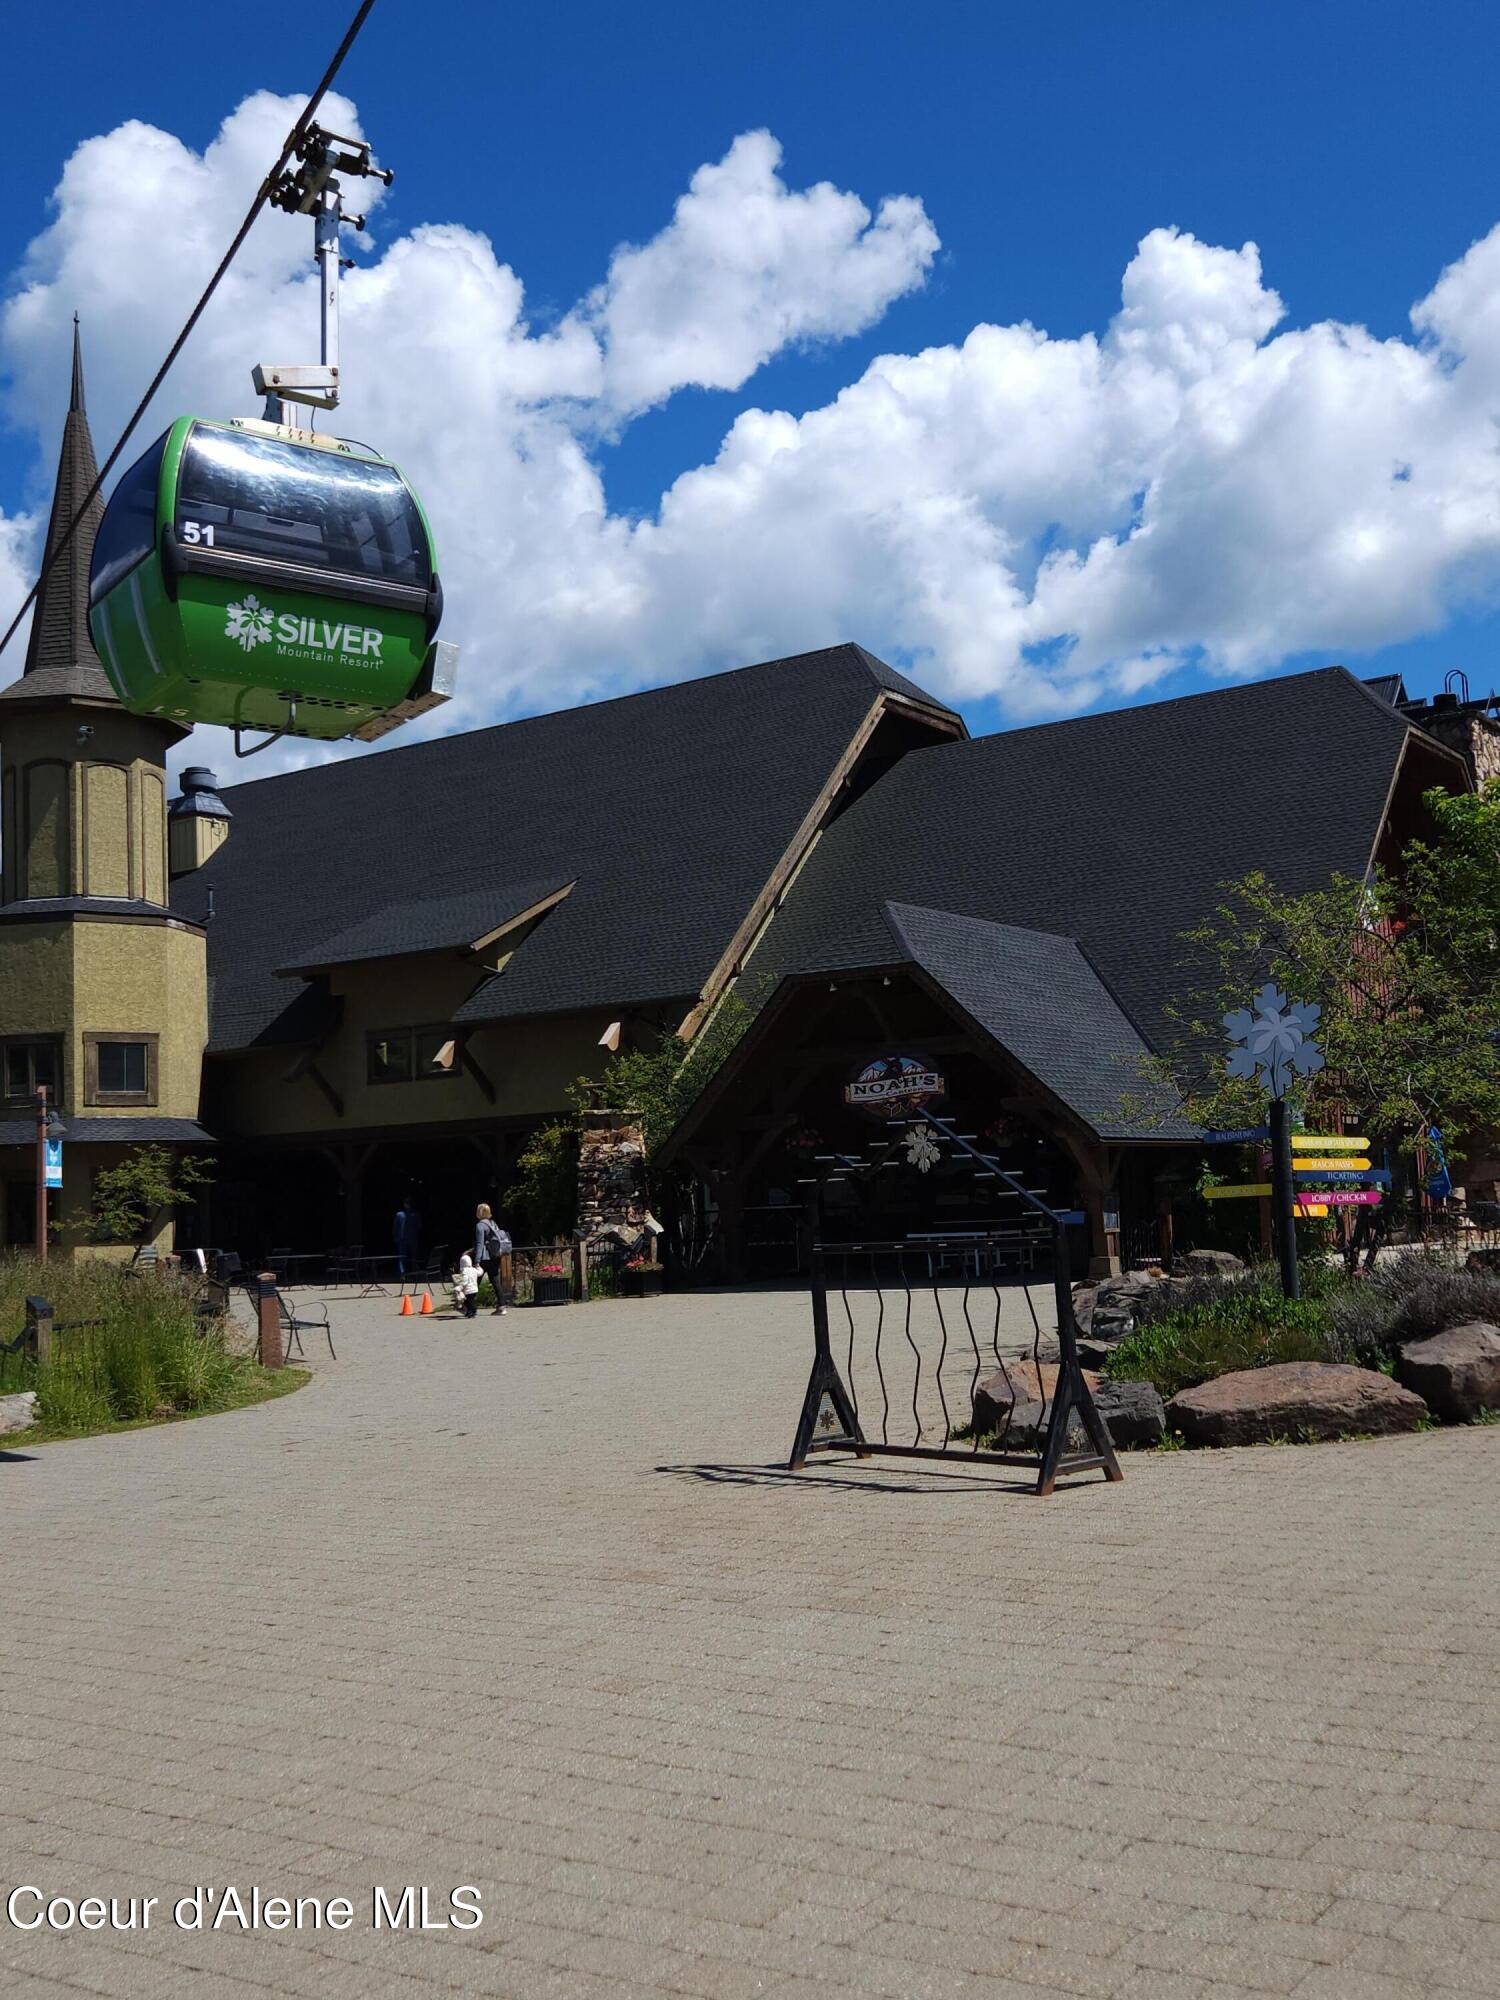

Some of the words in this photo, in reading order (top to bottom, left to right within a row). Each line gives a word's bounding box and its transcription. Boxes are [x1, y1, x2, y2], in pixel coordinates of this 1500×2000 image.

[184, 520, 214, 547] 51
[276, 613, 384, 657] SILVER
[277, 644, 334, 662] Mountain
[854, 1075, 936, 1095] NOAH'S
[1327, 1172, 1364, 1181] TICKETING
[1311, 1193, 1332, 1203] LOBBY
[1336, 1193, 1367, 1203] CHECK-IN
